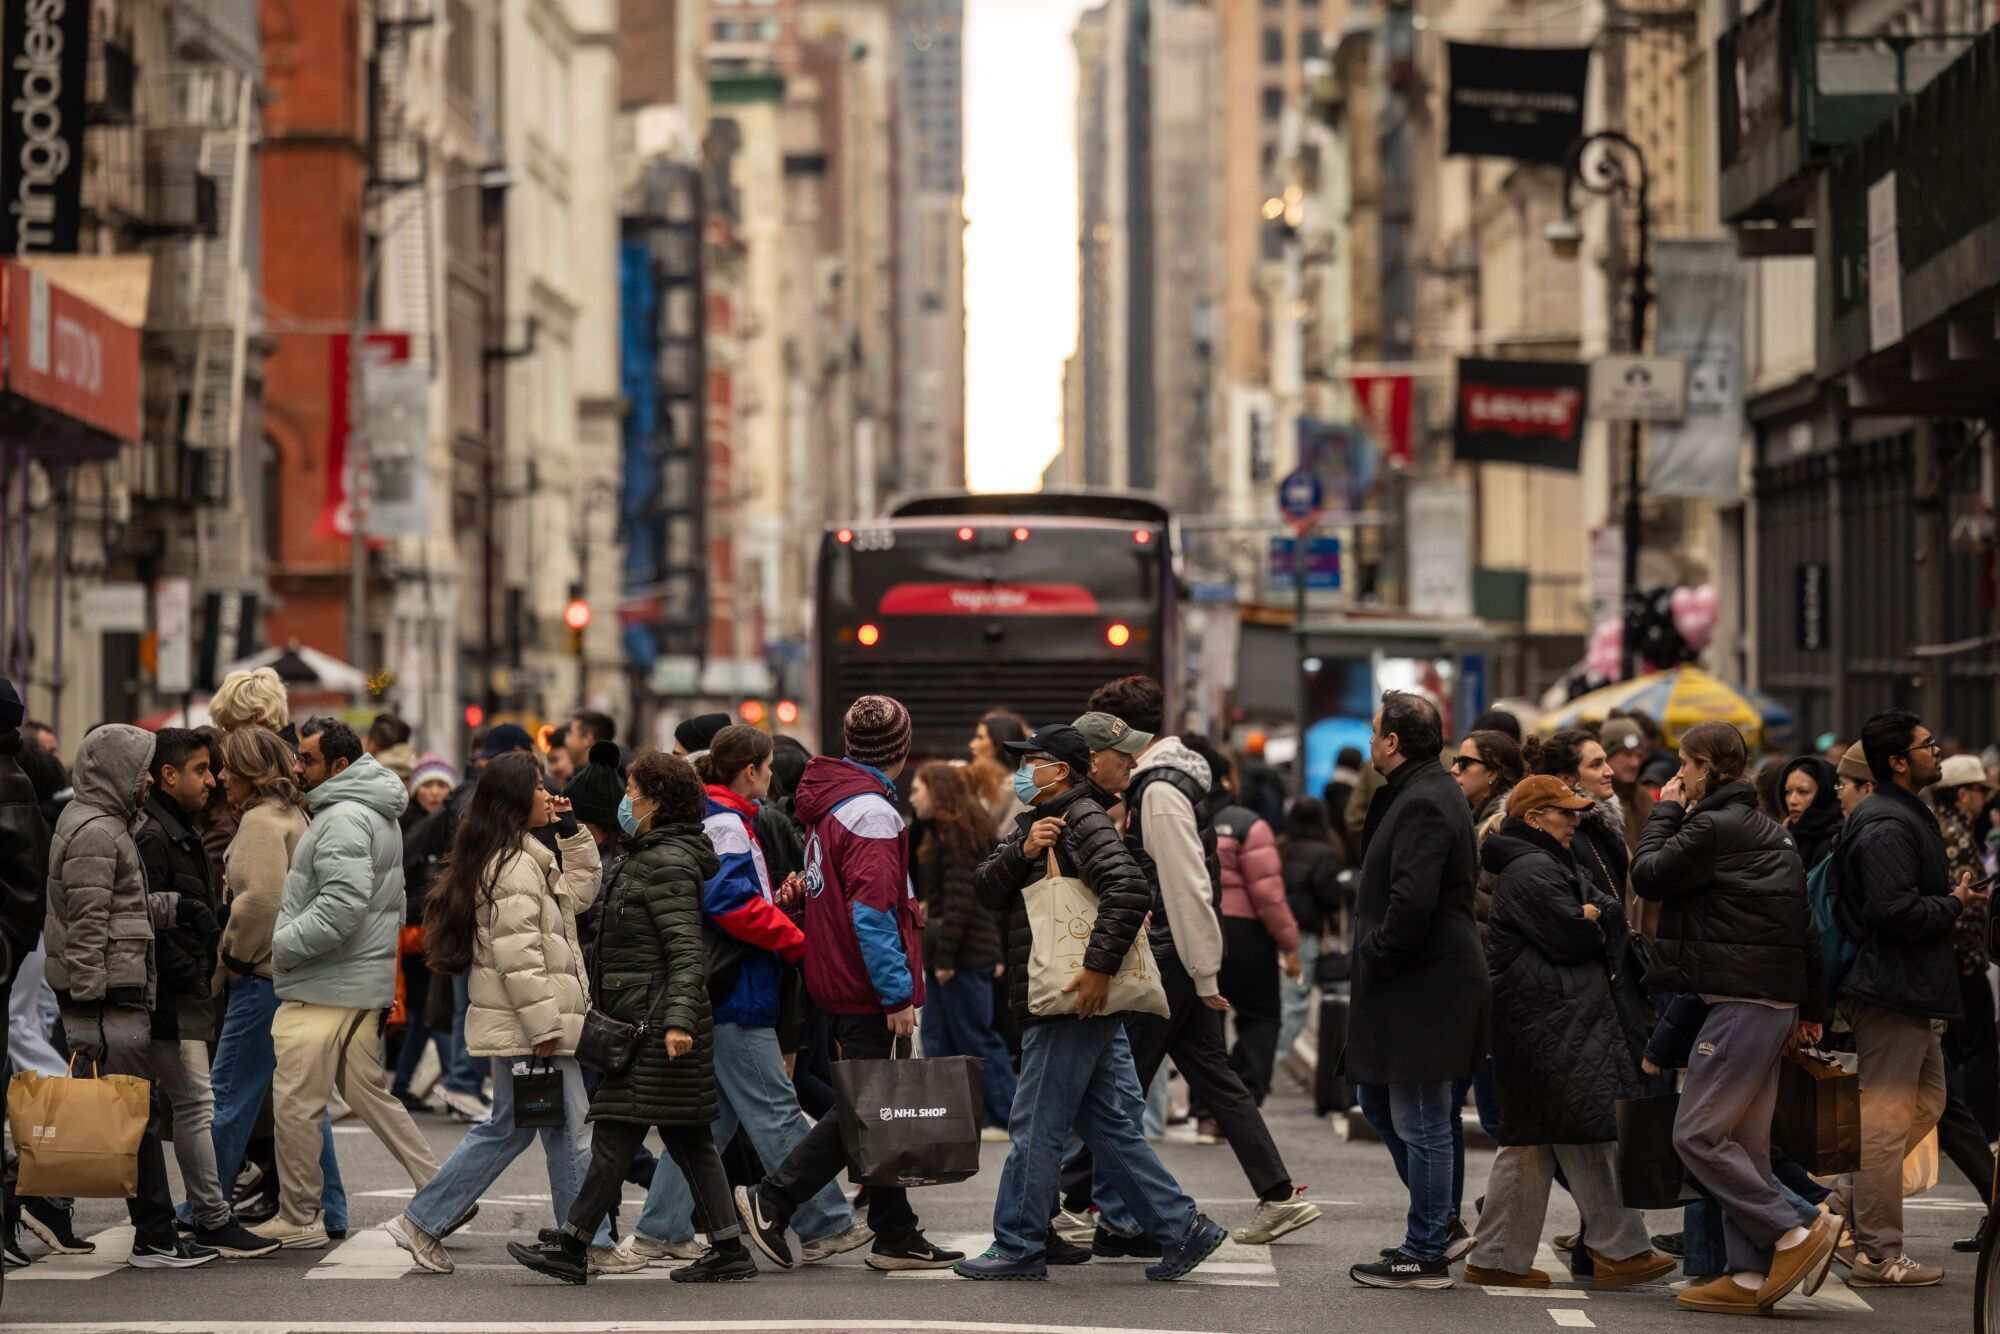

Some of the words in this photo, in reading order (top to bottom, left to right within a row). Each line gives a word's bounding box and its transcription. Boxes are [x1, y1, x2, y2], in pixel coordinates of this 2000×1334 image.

[894, 1108, 918, 1118] NHL
[918, 1107, 947, 1117] SHOP
[1391, 1263, 1421, 1273] HOKA
